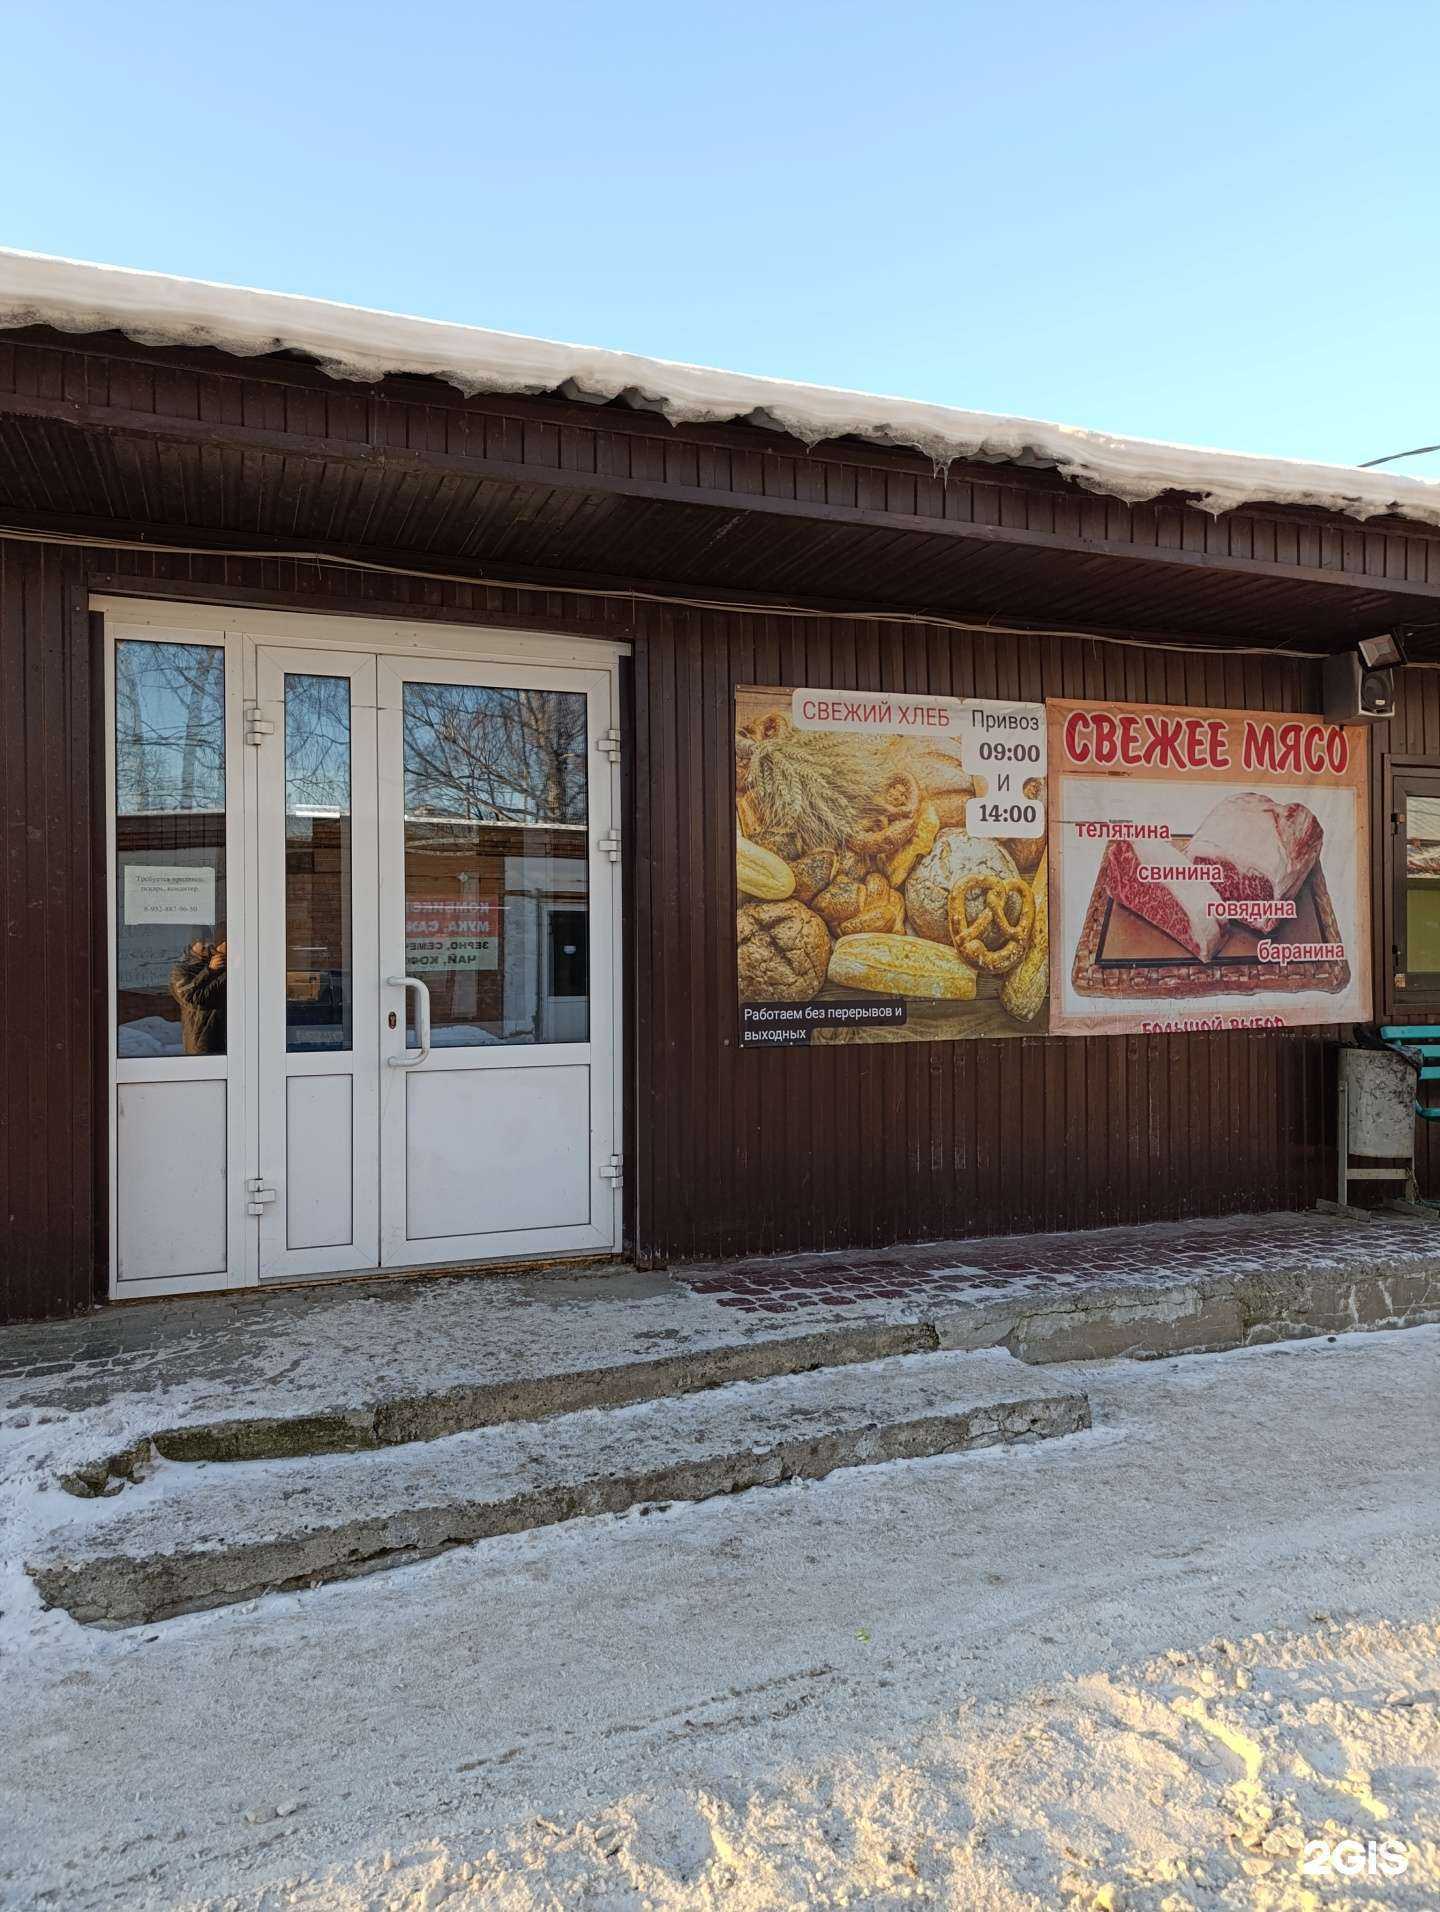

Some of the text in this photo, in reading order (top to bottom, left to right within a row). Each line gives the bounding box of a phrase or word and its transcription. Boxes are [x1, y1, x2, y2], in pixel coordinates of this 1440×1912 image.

[802, 699, 951, 727] СВЕЖИЙ ХЛЕБ
[971, 709, 1040, 732] Привоз
[979, 742, 1041, 763] 09:00
[1064, 711, 1350, 775] СВЕЖЕЕ МЯСО
[997, 774, 1010, 792] И
[979, 804, 1037, 823] 14:00
[1075, 821, 1170, 840] телятина
[1137, 865, 1222, 882] свинина
[1207, 902, 1296, 920] говядина
[1258, 940, 1345, 965] баранина
[744, 1006, 902, 1021] Работаем без перерывов и
[744, 1028, 807, 1042] выходных
